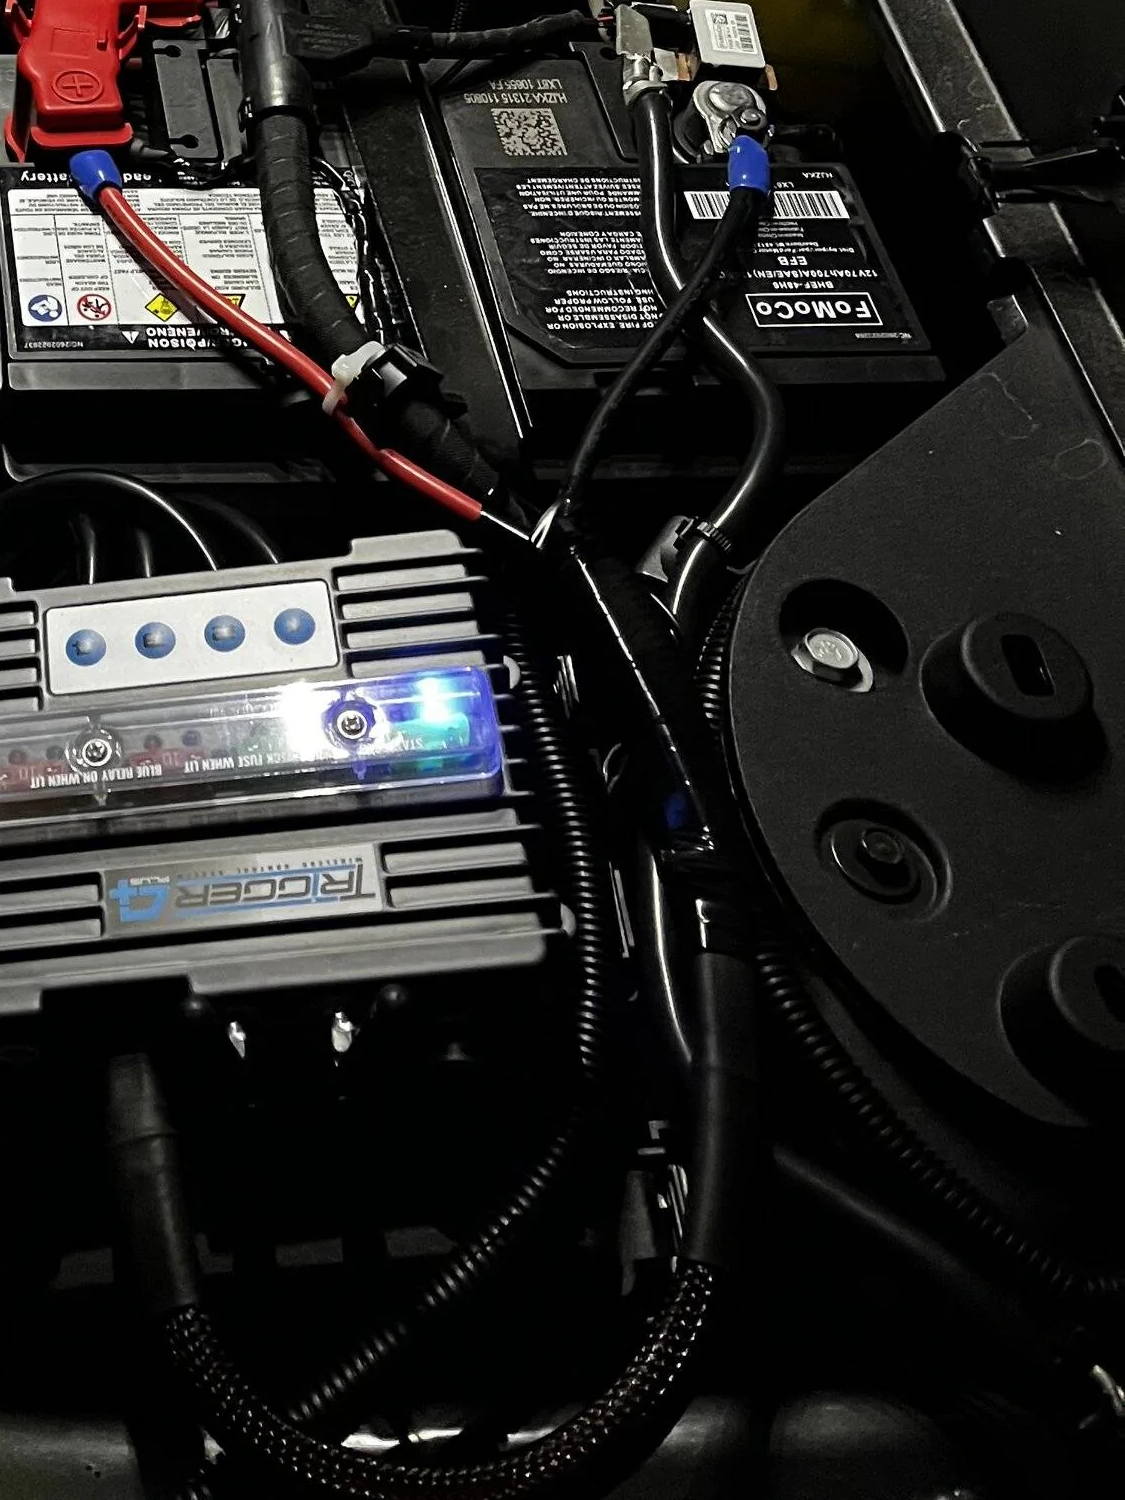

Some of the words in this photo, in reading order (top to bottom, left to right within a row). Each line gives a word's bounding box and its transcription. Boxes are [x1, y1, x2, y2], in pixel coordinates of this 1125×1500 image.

[501, 93, 532, 103] 21315
[777, 256, 808, 266] EFB
[756, 300, 871, 319] FoMoCo
[573, 313, 637, 321] DISASSEMBLE
[184, 760, 199, 773] LIT
[201, 756, 235, 771] WHEN
[237, 754, 263, 767] FUSE
[82, 770, 98, 782] ON
[102, 766, 133, 780] RELAY
[136, 764, 162, 777] BLUE
[30, 776, 46, 789] LIT
[47, 772, 80, 786] WHEN
[175, 863, 375, 909] TRIGGER
[108, 879, 170, 924] 4
